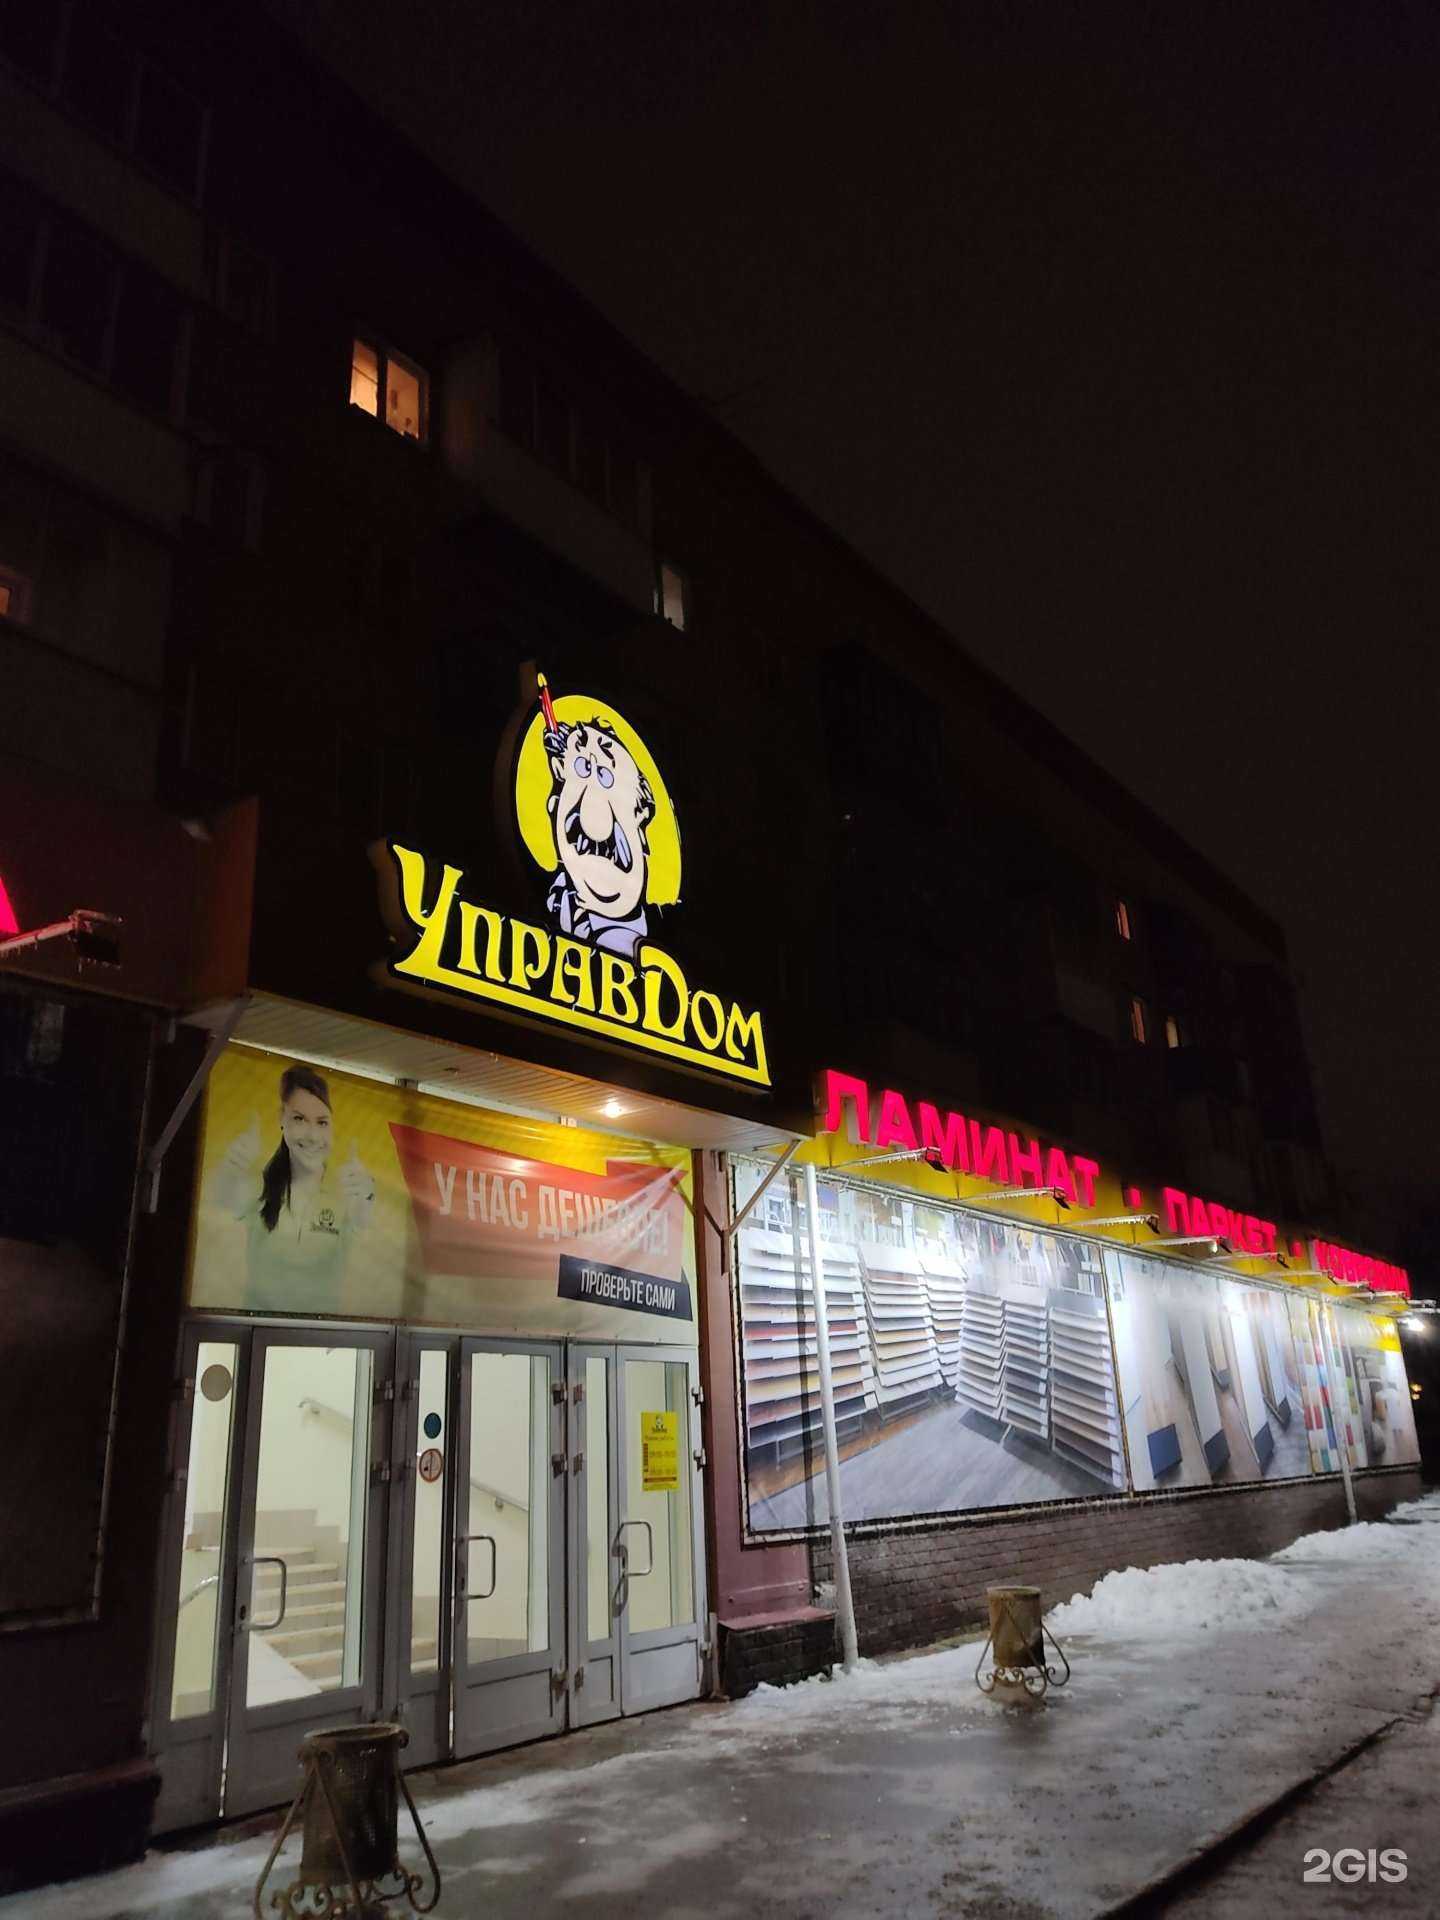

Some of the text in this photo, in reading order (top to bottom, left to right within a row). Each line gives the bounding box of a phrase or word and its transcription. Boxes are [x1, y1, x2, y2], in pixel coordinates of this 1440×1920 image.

[434, 1163, 456, 1215] У
[466, 1170, 528, 1230] НАС
[824, 1069, 1100, 1208] ЛАМИНАТ
[1163, 1187, 1277, 1257] ПАРКЕТ
[580, 1268, 676, 1311] ПРОВЕРЬТЕ САМИ
